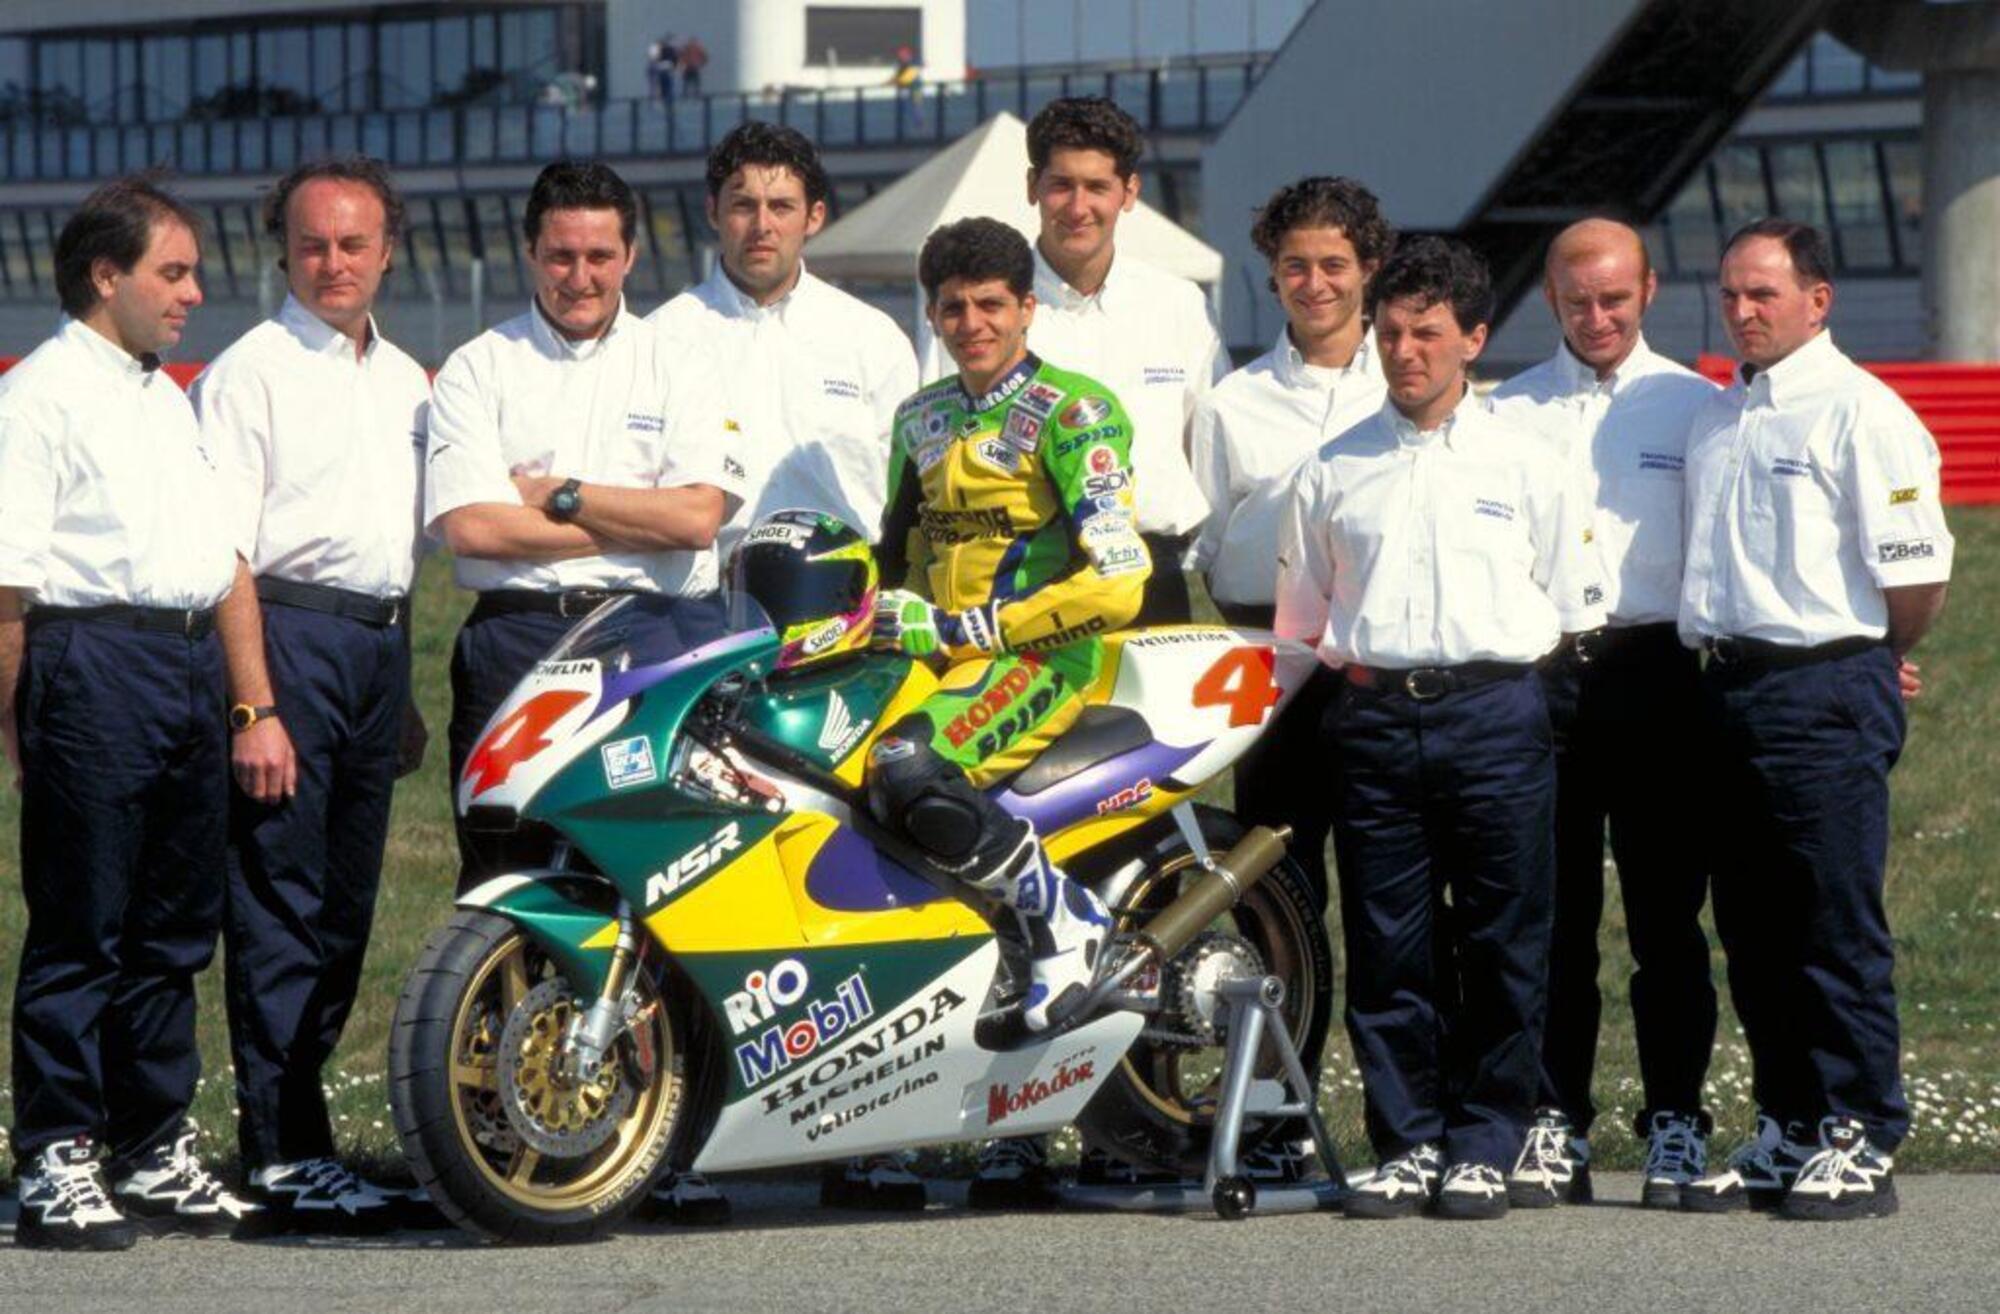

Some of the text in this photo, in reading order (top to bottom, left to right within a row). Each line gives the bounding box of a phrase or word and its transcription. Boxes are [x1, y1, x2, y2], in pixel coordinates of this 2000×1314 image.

[1897, 542, 1934, 558] Beta
[809, 622, 844, 649] SHOEI
[1191, 645, 1285, 729] 4
[463, 690, 593, 800] 4
[645, 820, 743, 908] NSR
[735, 972, 875, 1088] Mobil
[760, 986, 967, 1116] HONDA
[789, 1032, 947, 1127] MICHELIN
